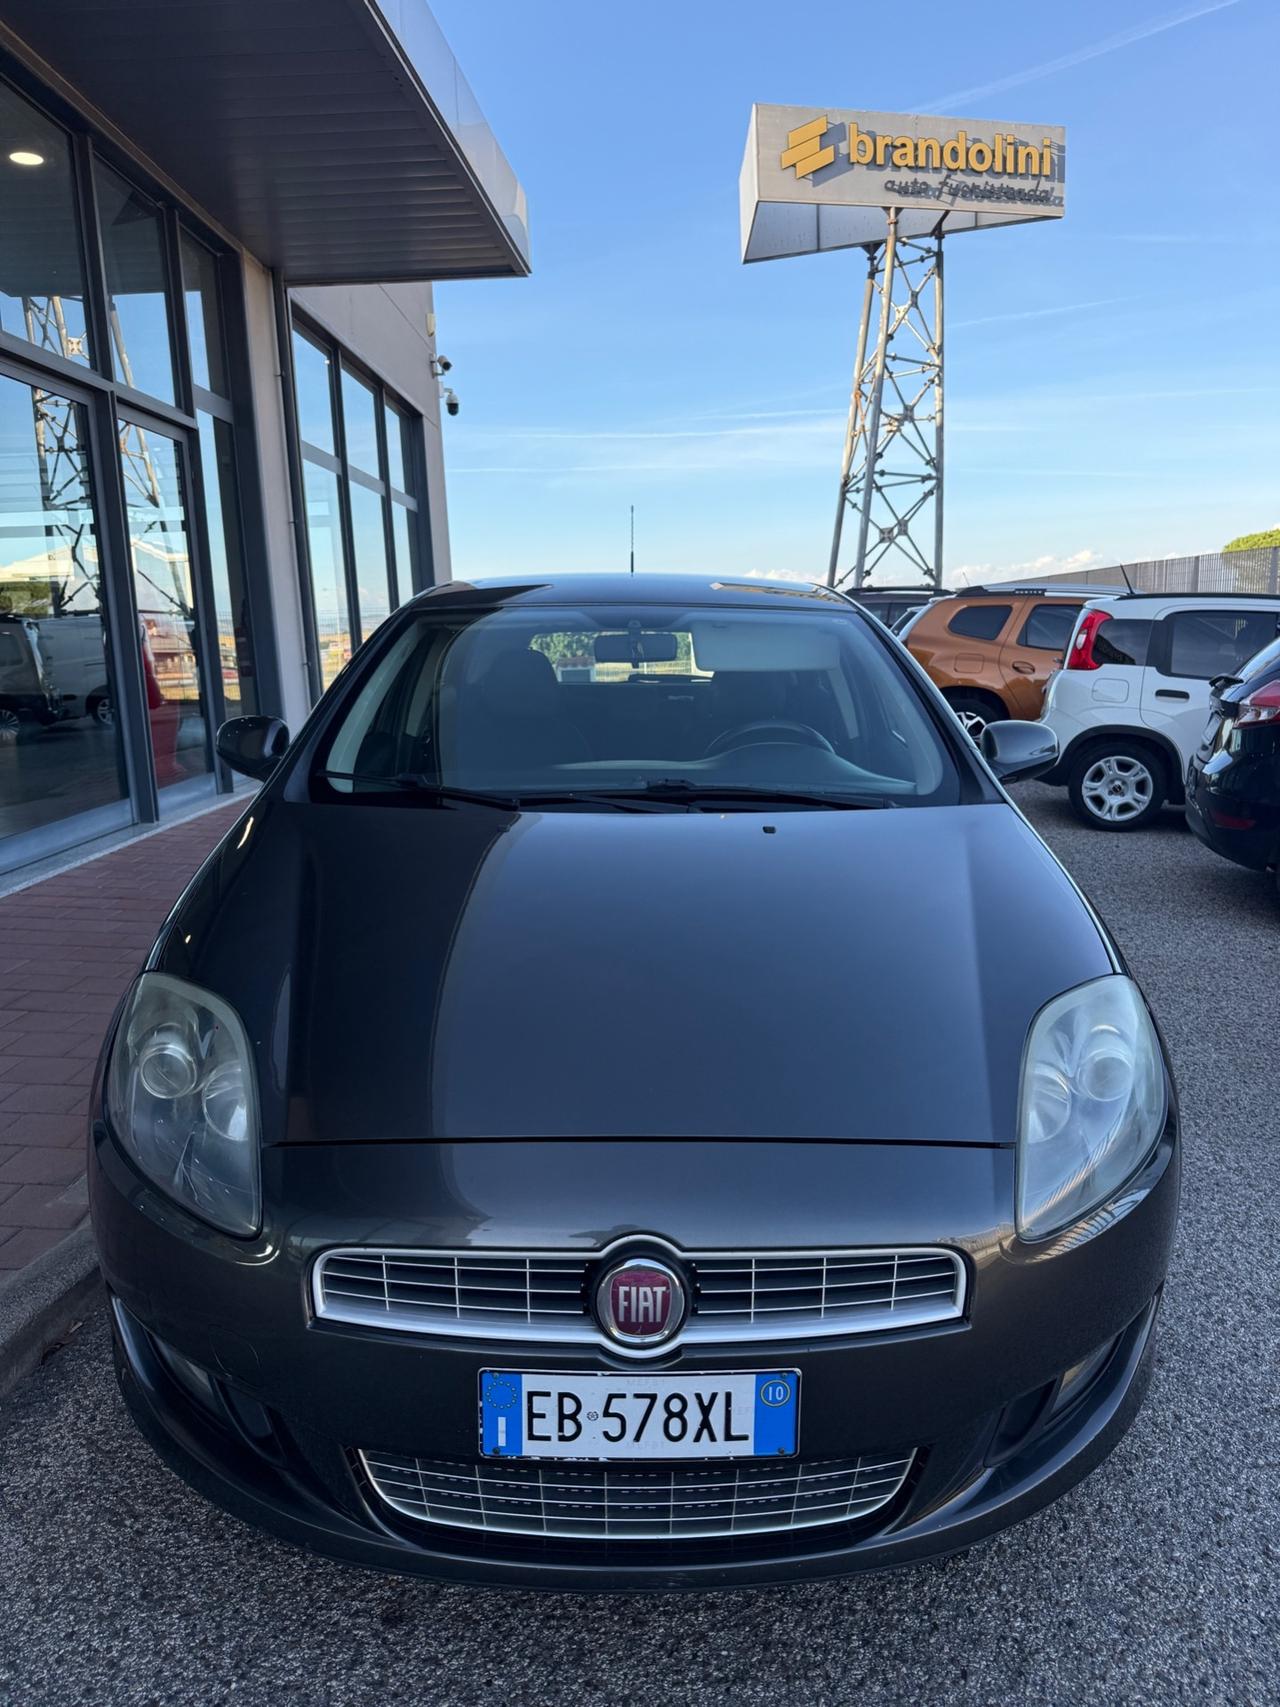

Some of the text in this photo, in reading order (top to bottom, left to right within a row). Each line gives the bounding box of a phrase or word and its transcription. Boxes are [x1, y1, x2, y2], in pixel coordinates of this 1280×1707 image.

[849, 122, 1051, 176] brandolini
[618, 1286, 667, 1323] FIAT
[768, 1385, 784, 1401] 10
[526, 1391, 750, 1443] EB 578XL
